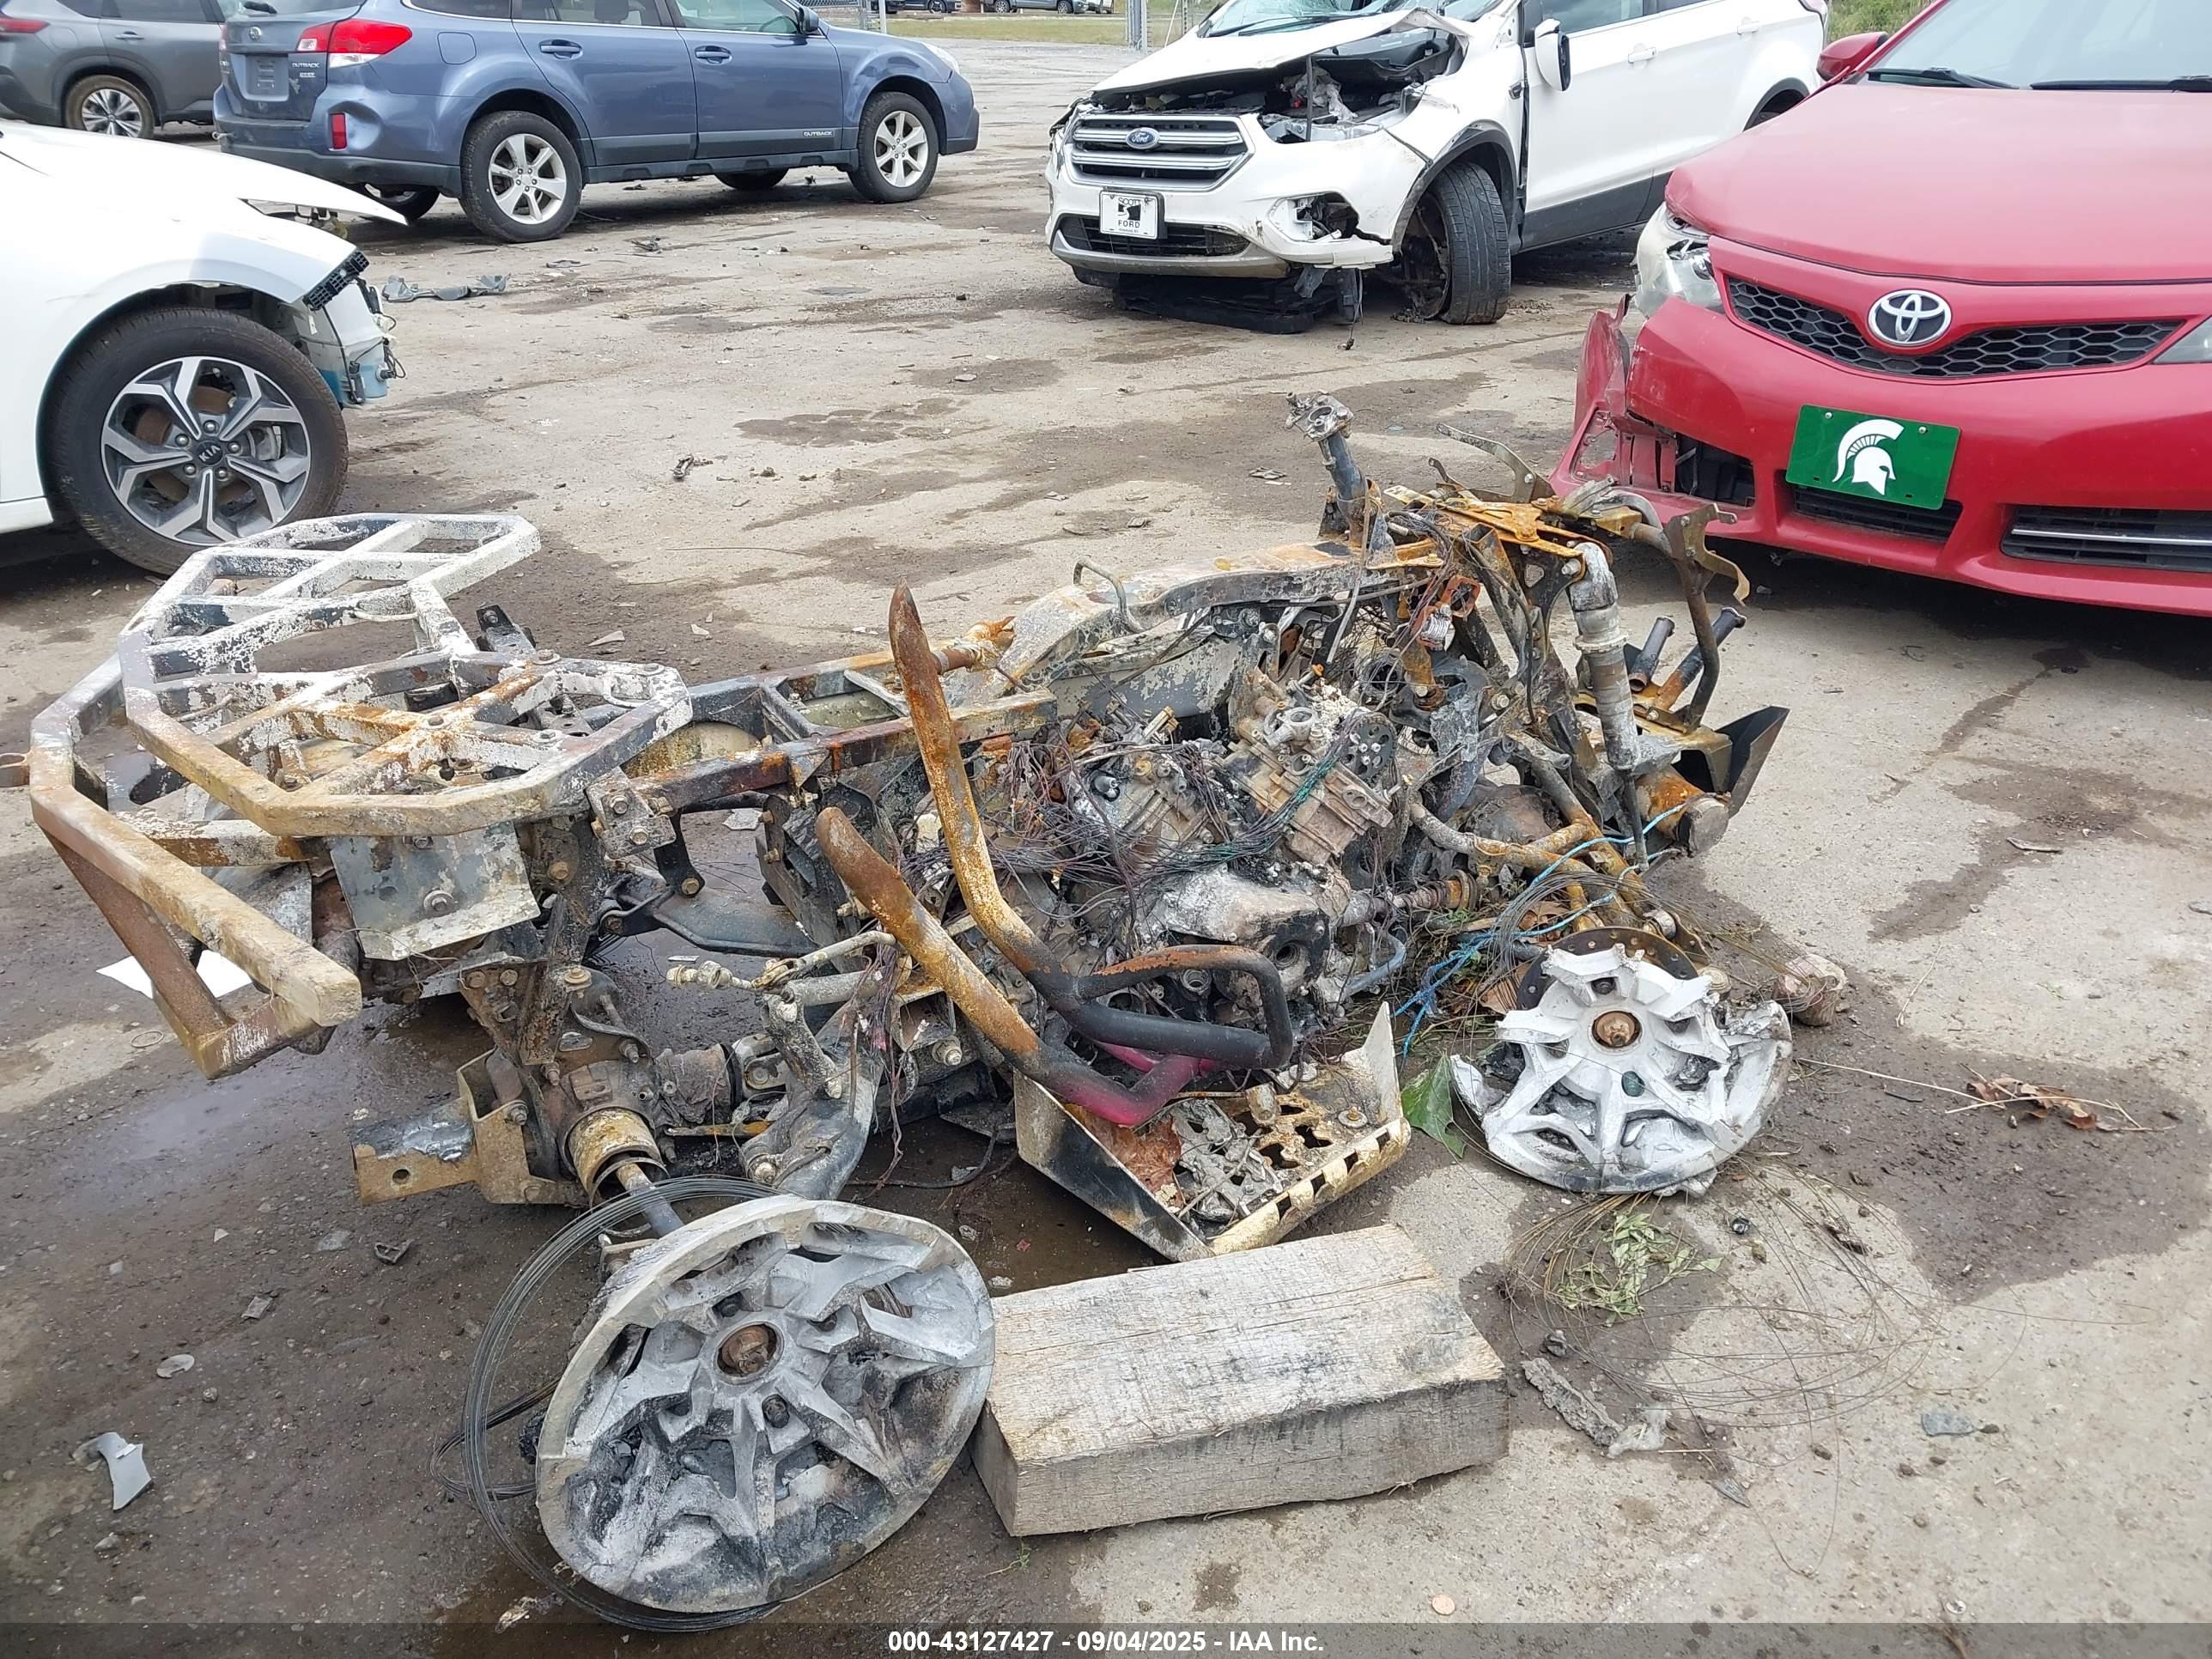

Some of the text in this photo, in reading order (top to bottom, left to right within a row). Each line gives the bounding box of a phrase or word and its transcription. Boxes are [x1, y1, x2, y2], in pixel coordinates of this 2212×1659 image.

[1118, 197, 1142, 206] SCOTT
[1118, 219, 1140, 228] FORD
[198, 445, 221, 462] KIA
